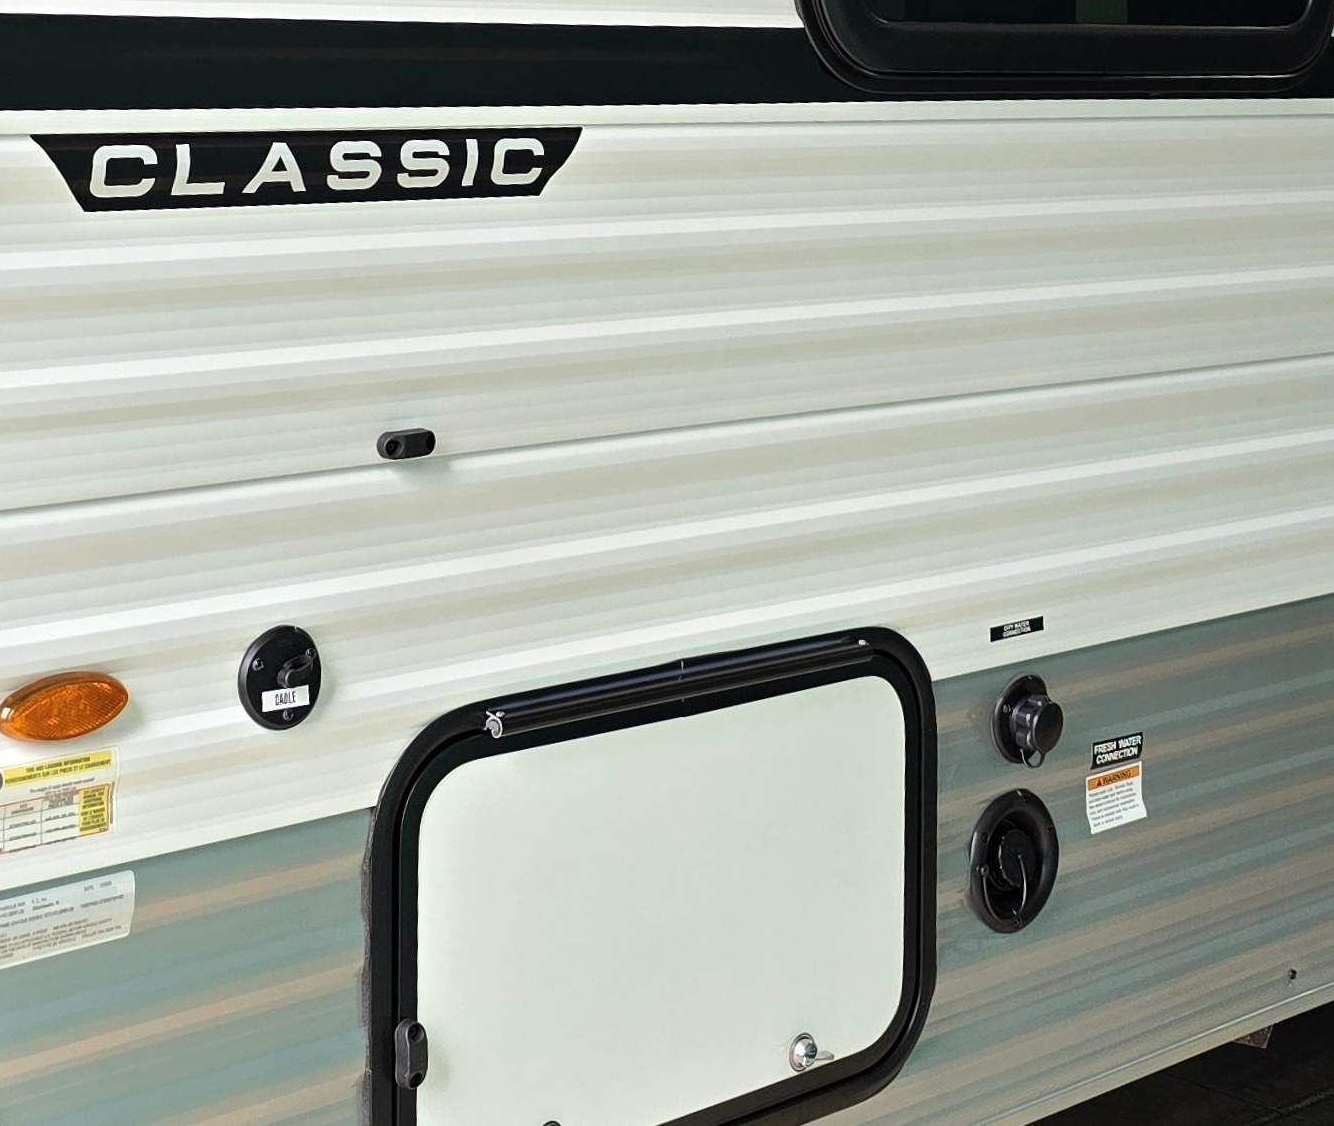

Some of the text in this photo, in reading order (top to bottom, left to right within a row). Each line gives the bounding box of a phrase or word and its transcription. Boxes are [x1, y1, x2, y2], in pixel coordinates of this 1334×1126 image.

[89, 138, 545, 198] CLASSIC
[1094, 735, 1142, 755] FRESH WATER
[1096, 746, 1138, 764] CONNECTION
